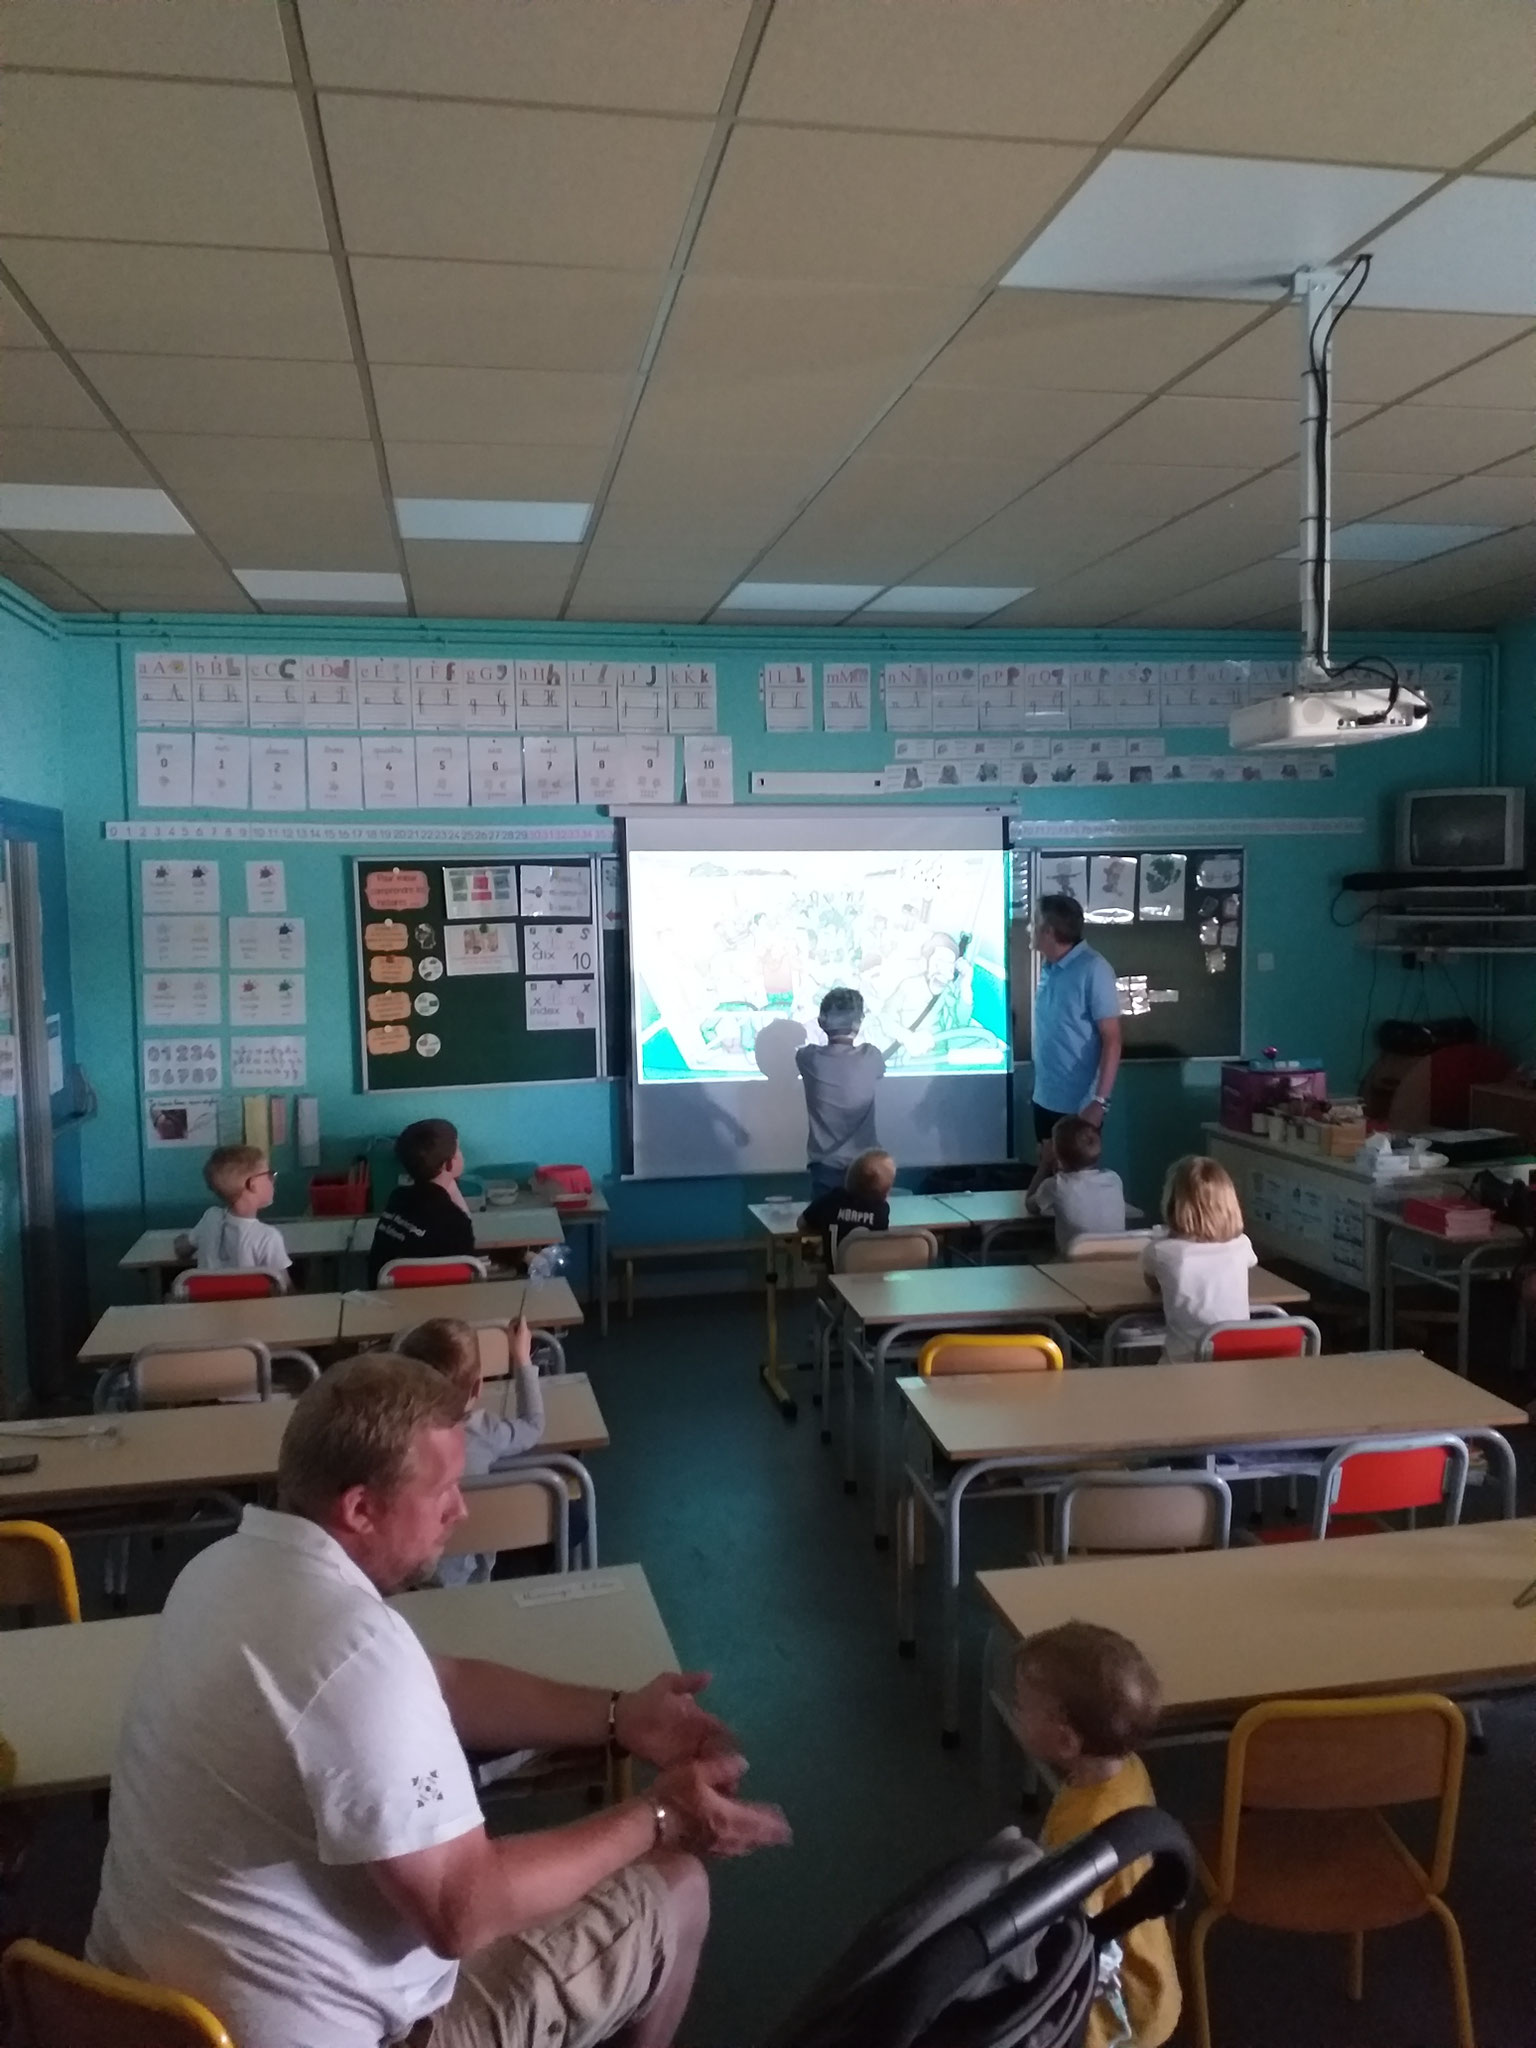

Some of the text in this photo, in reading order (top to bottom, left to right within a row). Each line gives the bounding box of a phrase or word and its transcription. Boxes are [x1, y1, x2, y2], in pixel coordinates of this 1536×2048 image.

[153, 661, 165, 674] A
[685, 670, 696, 683] K
[274, 762, 281, 773] 2
[331, 761, 338, 772] 3
[385, 762, 392, 771] 4
[439, 760, 446, 771] 5
[491, 761, 499, 772] 6
[546, 761, 553, 770] 7
[598, 759, 605, 770] 8
[647, 758, 653, 769] 9
[703, 759, 715, 770] 10
[531, 950, 592, 971] dix 10
[530, 1003, 561, 1015] index
